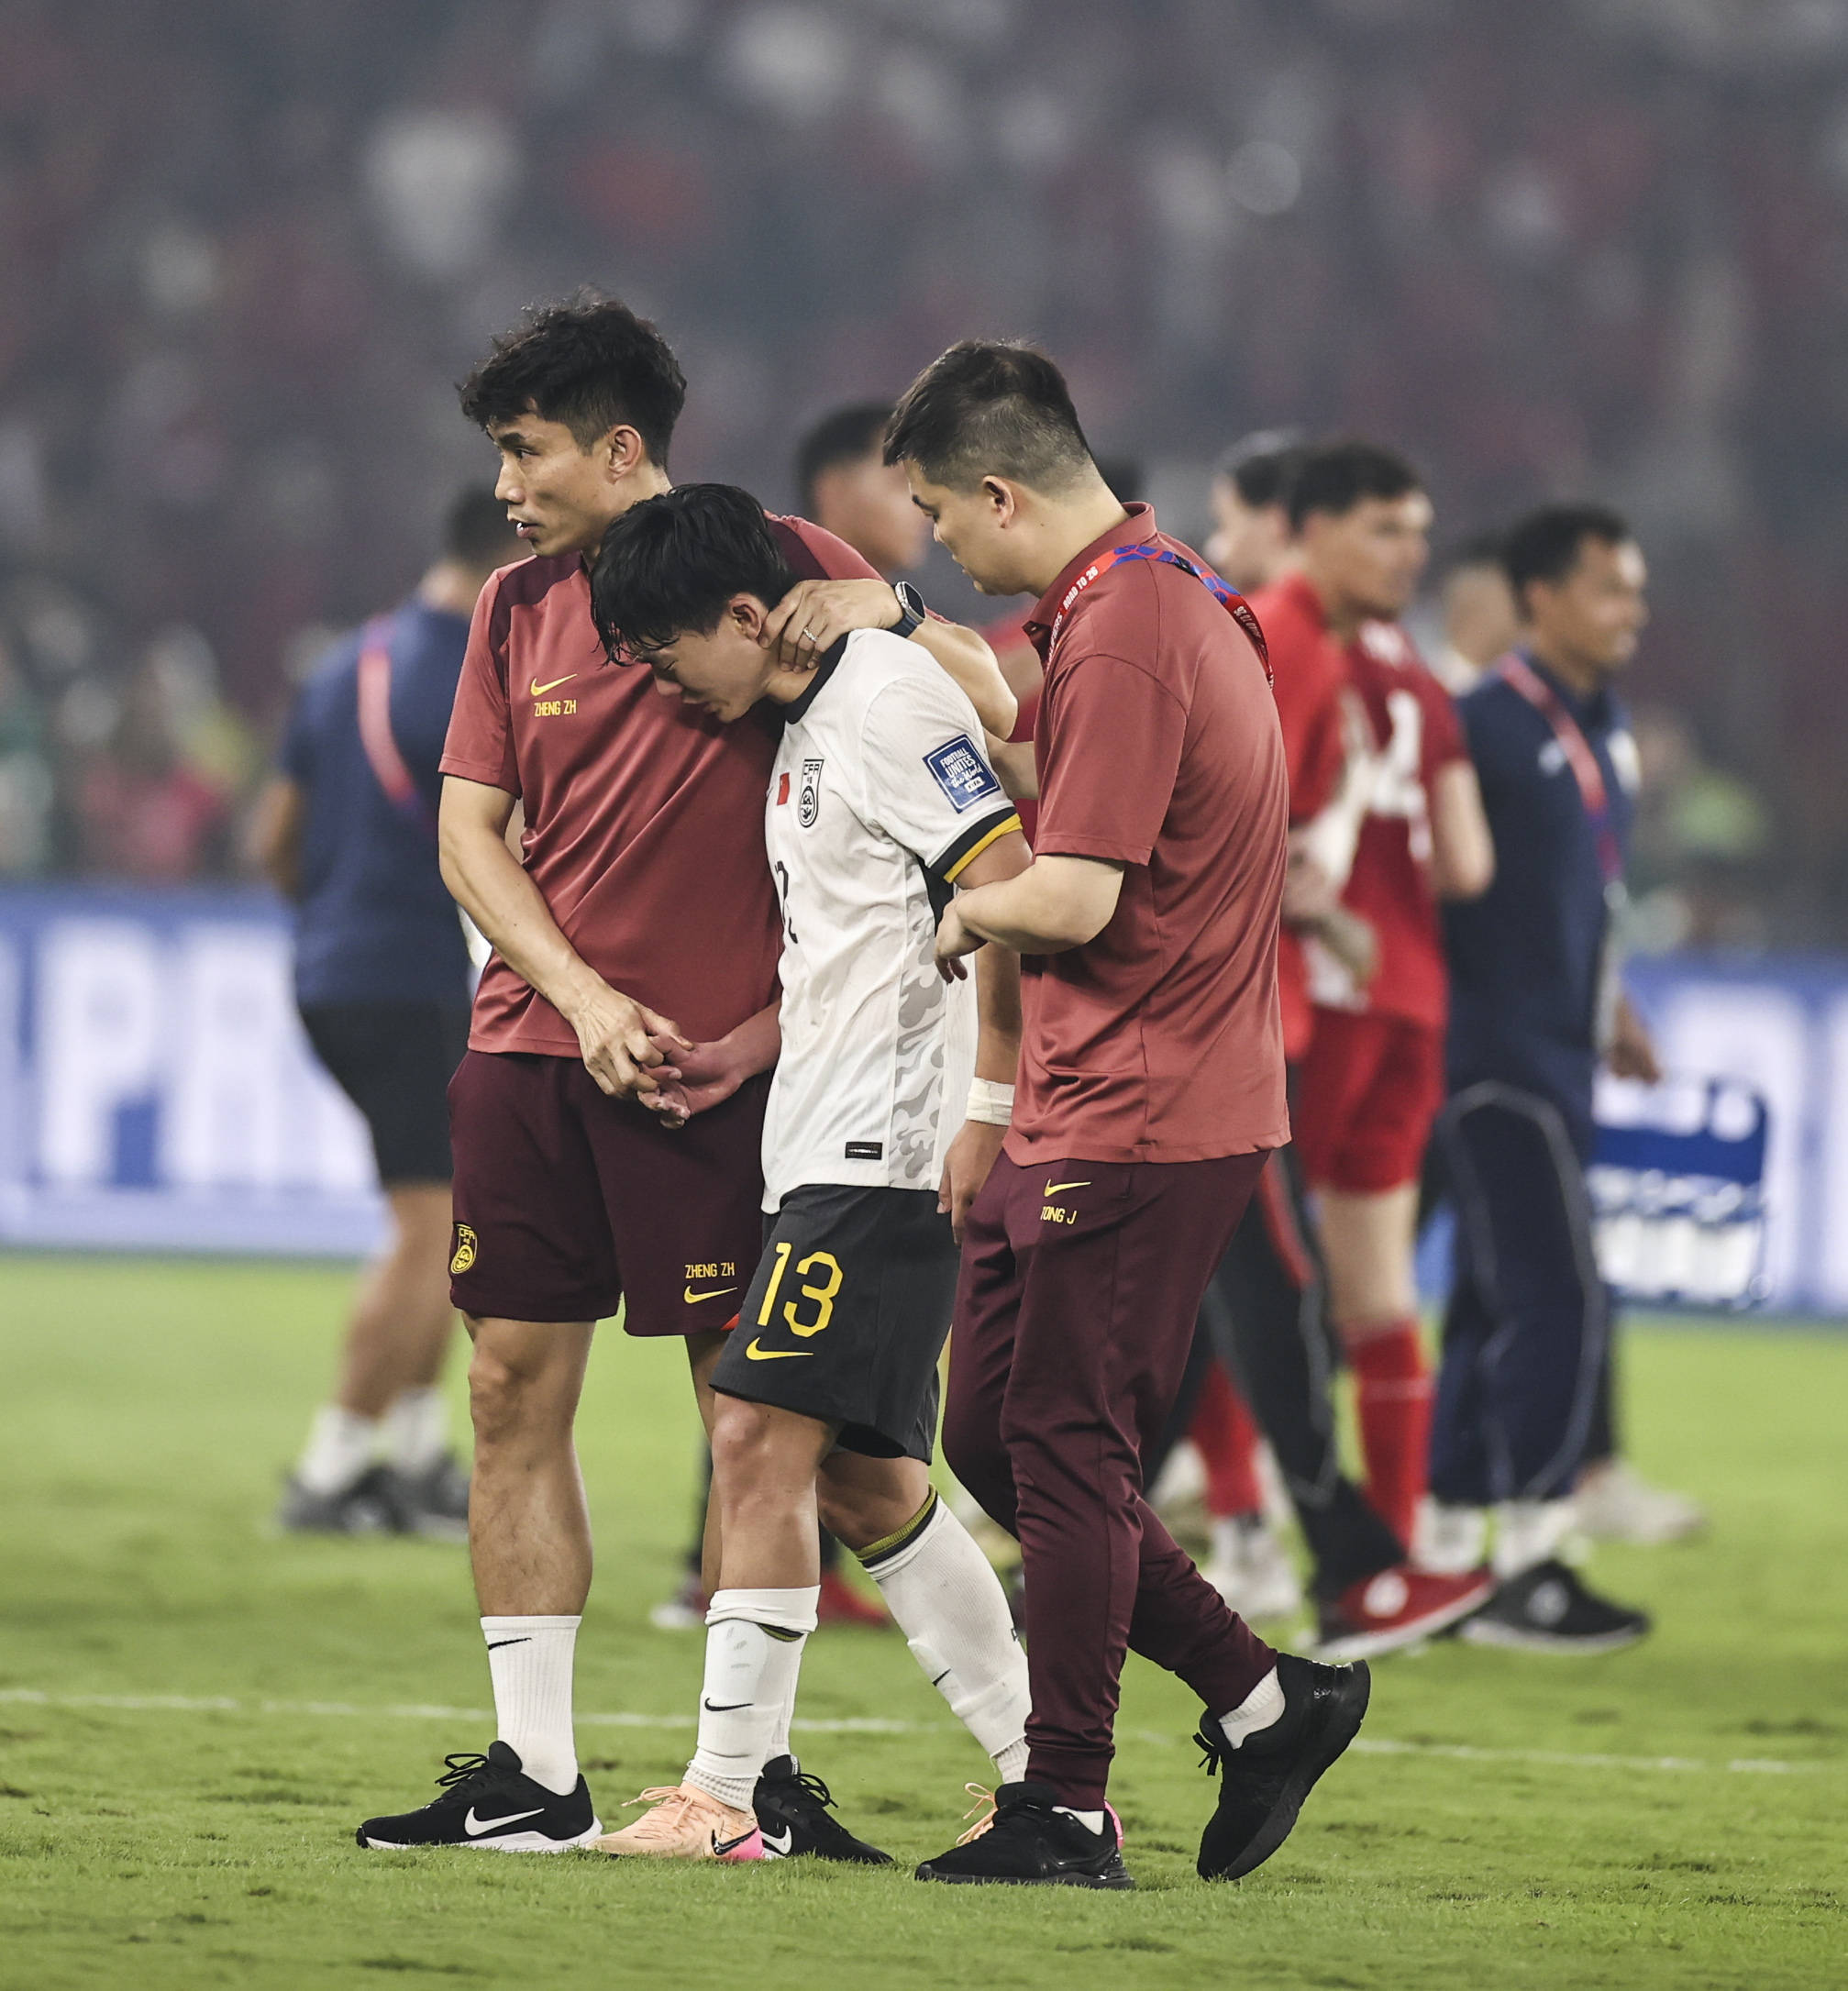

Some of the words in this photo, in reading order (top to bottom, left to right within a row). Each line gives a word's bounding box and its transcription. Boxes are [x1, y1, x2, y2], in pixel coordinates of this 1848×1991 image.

[1063, 586, 1079, 610] ROAD
[1076, 577, 1088, 590] TO
[534, 701, 561, 717] ZHENG
[563, 699, 577, 714] ZH
[803, 763, 820, 775] CFA
[945, 754, 976, 779] UNITES
[1067, 1210, 1078, 1225] J
[684, 1264, 717, 1278] ZHENG
[720, 1262, 736, 1276] ZH
[758, 1242, 844, 1338] 13
